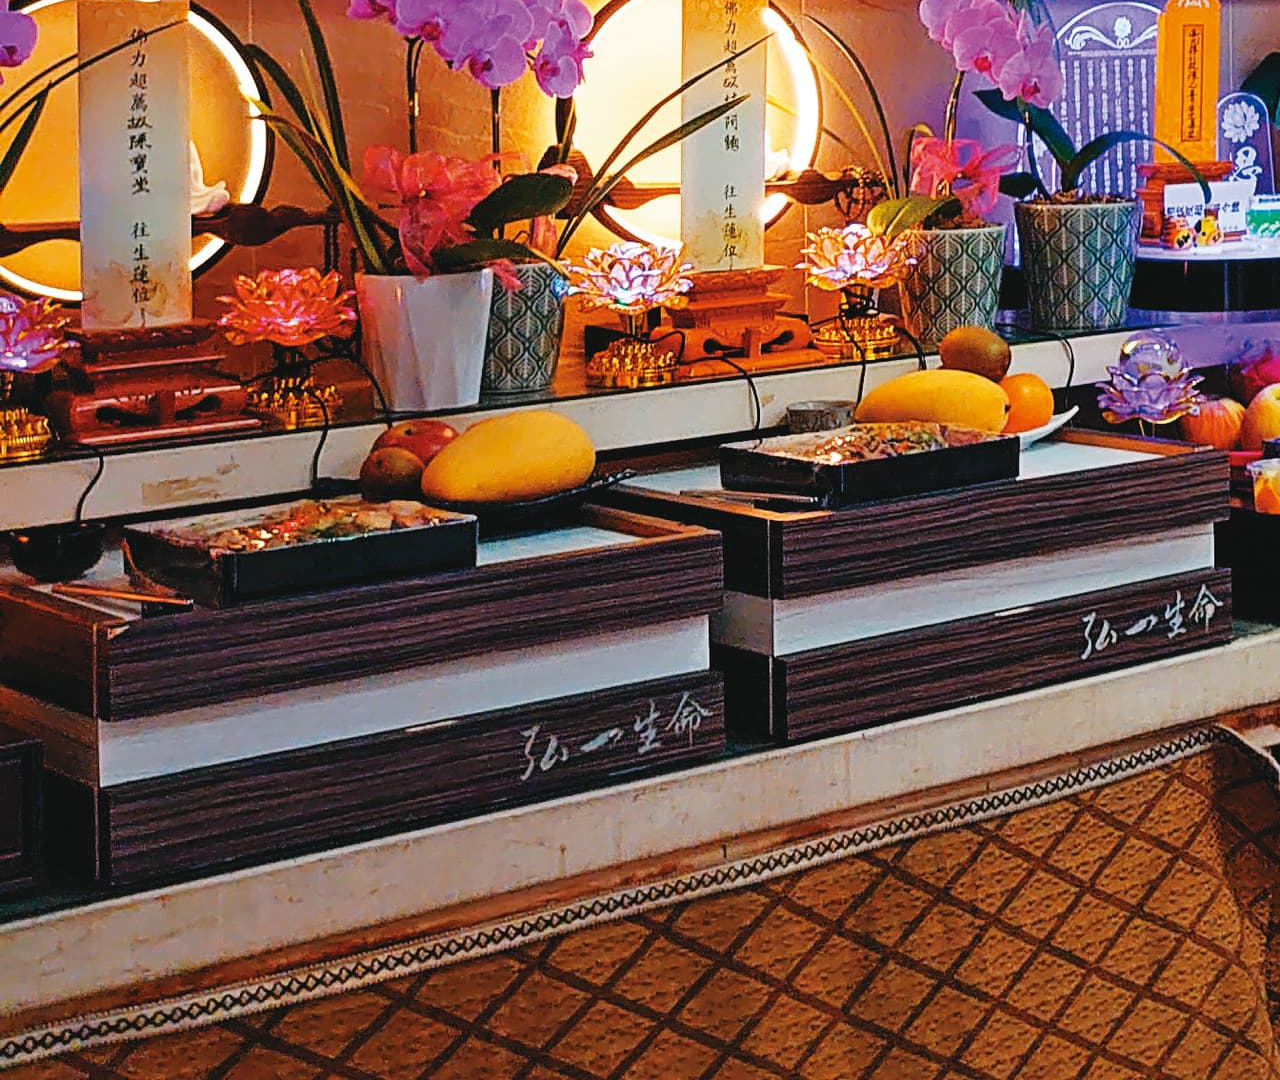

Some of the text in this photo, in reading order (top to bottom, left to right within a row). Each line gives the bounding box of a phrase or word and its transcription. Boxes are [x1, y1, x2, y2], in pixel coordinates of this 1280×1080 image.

[722, 184, 739, 258] 往生蓮位
[130, 221, 151, 305] 往生蓮位
[1081, 582, 1224, 661] 弘一生命
[520, 690, 714, 783] 弘一生命
